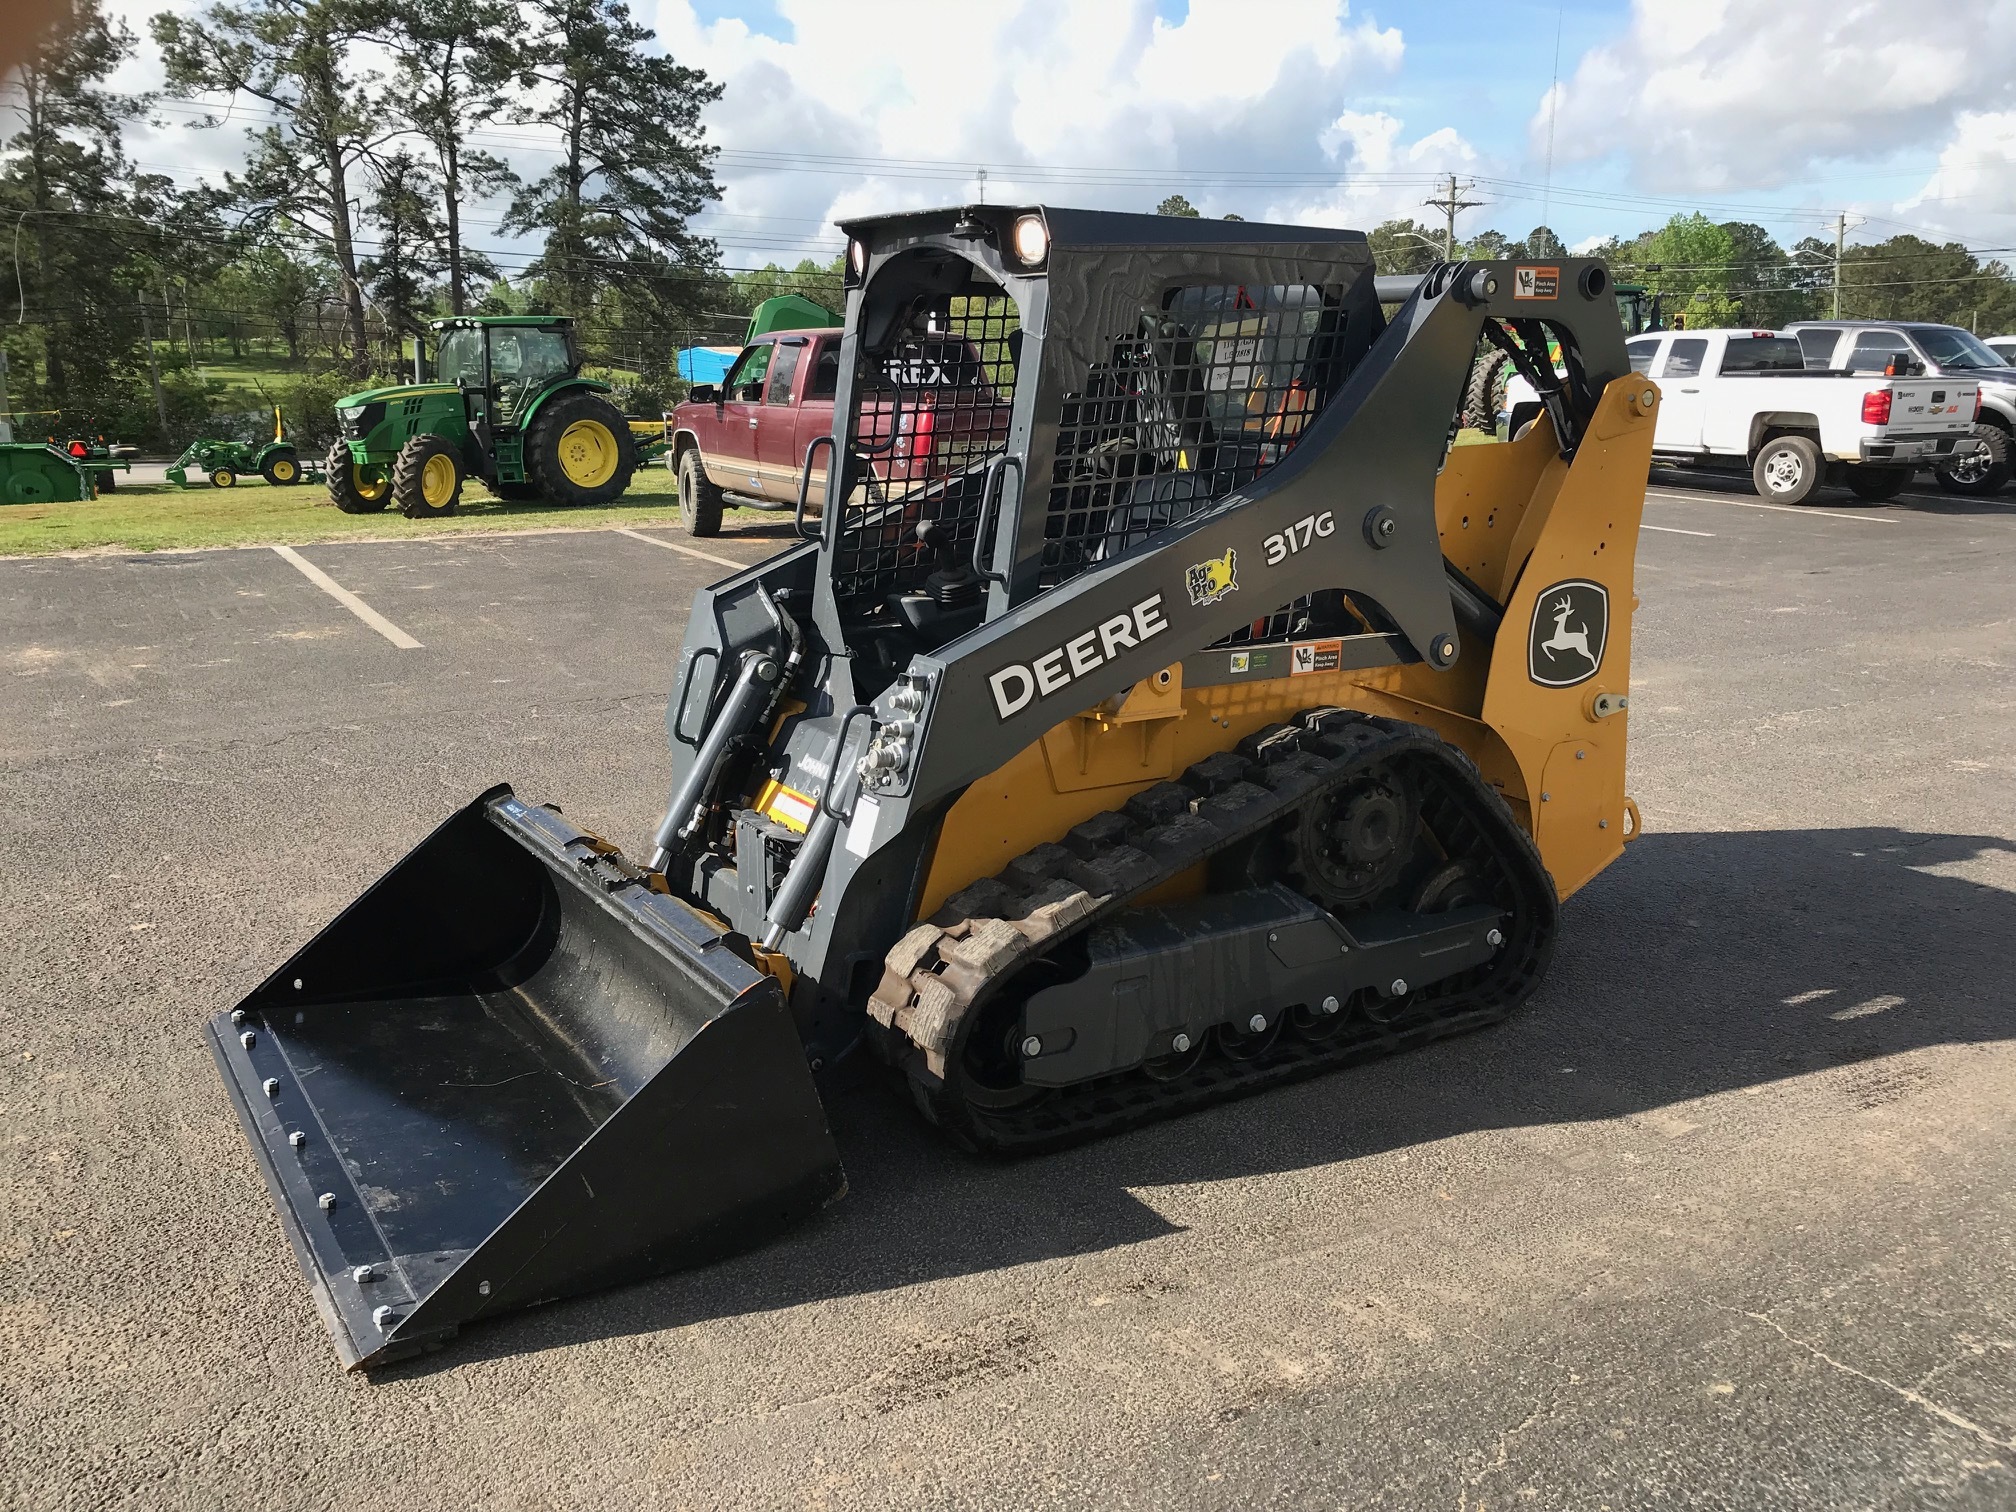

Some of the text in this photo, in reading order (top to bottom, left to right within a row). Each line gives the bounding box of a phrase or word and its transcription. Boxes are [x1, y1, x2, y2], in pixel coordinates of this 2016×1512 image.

[1263, 511, 1335, 566] 317G
[1191, 579, 1216, 601] Pro
[989, 593, 1168, 719] DEERE
